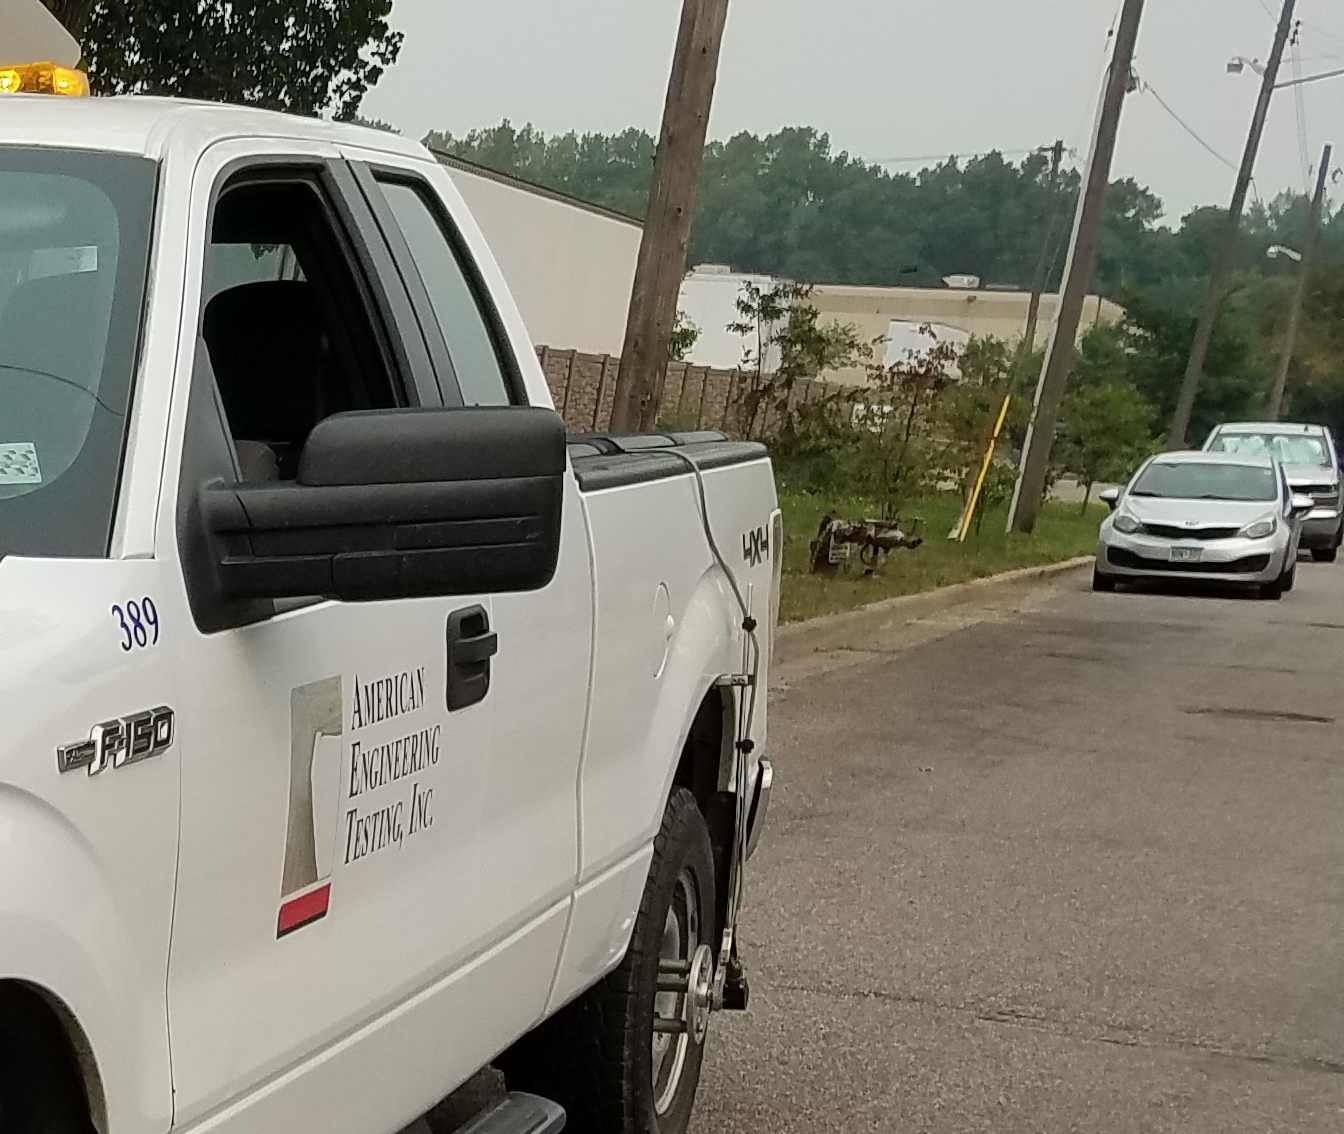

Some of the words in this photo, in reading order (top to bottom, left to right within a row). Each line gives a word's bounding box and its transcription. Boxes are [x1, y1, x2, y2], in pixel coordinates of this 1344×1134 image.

[111, 596, 159, 651] 389
[351, 667, 425, 731] AMERICAN
[348, 725, 441, 799] ENGINEERING
[344, 801, 403, 865] TESTING,
[408, 782, 433, 836] INC.
